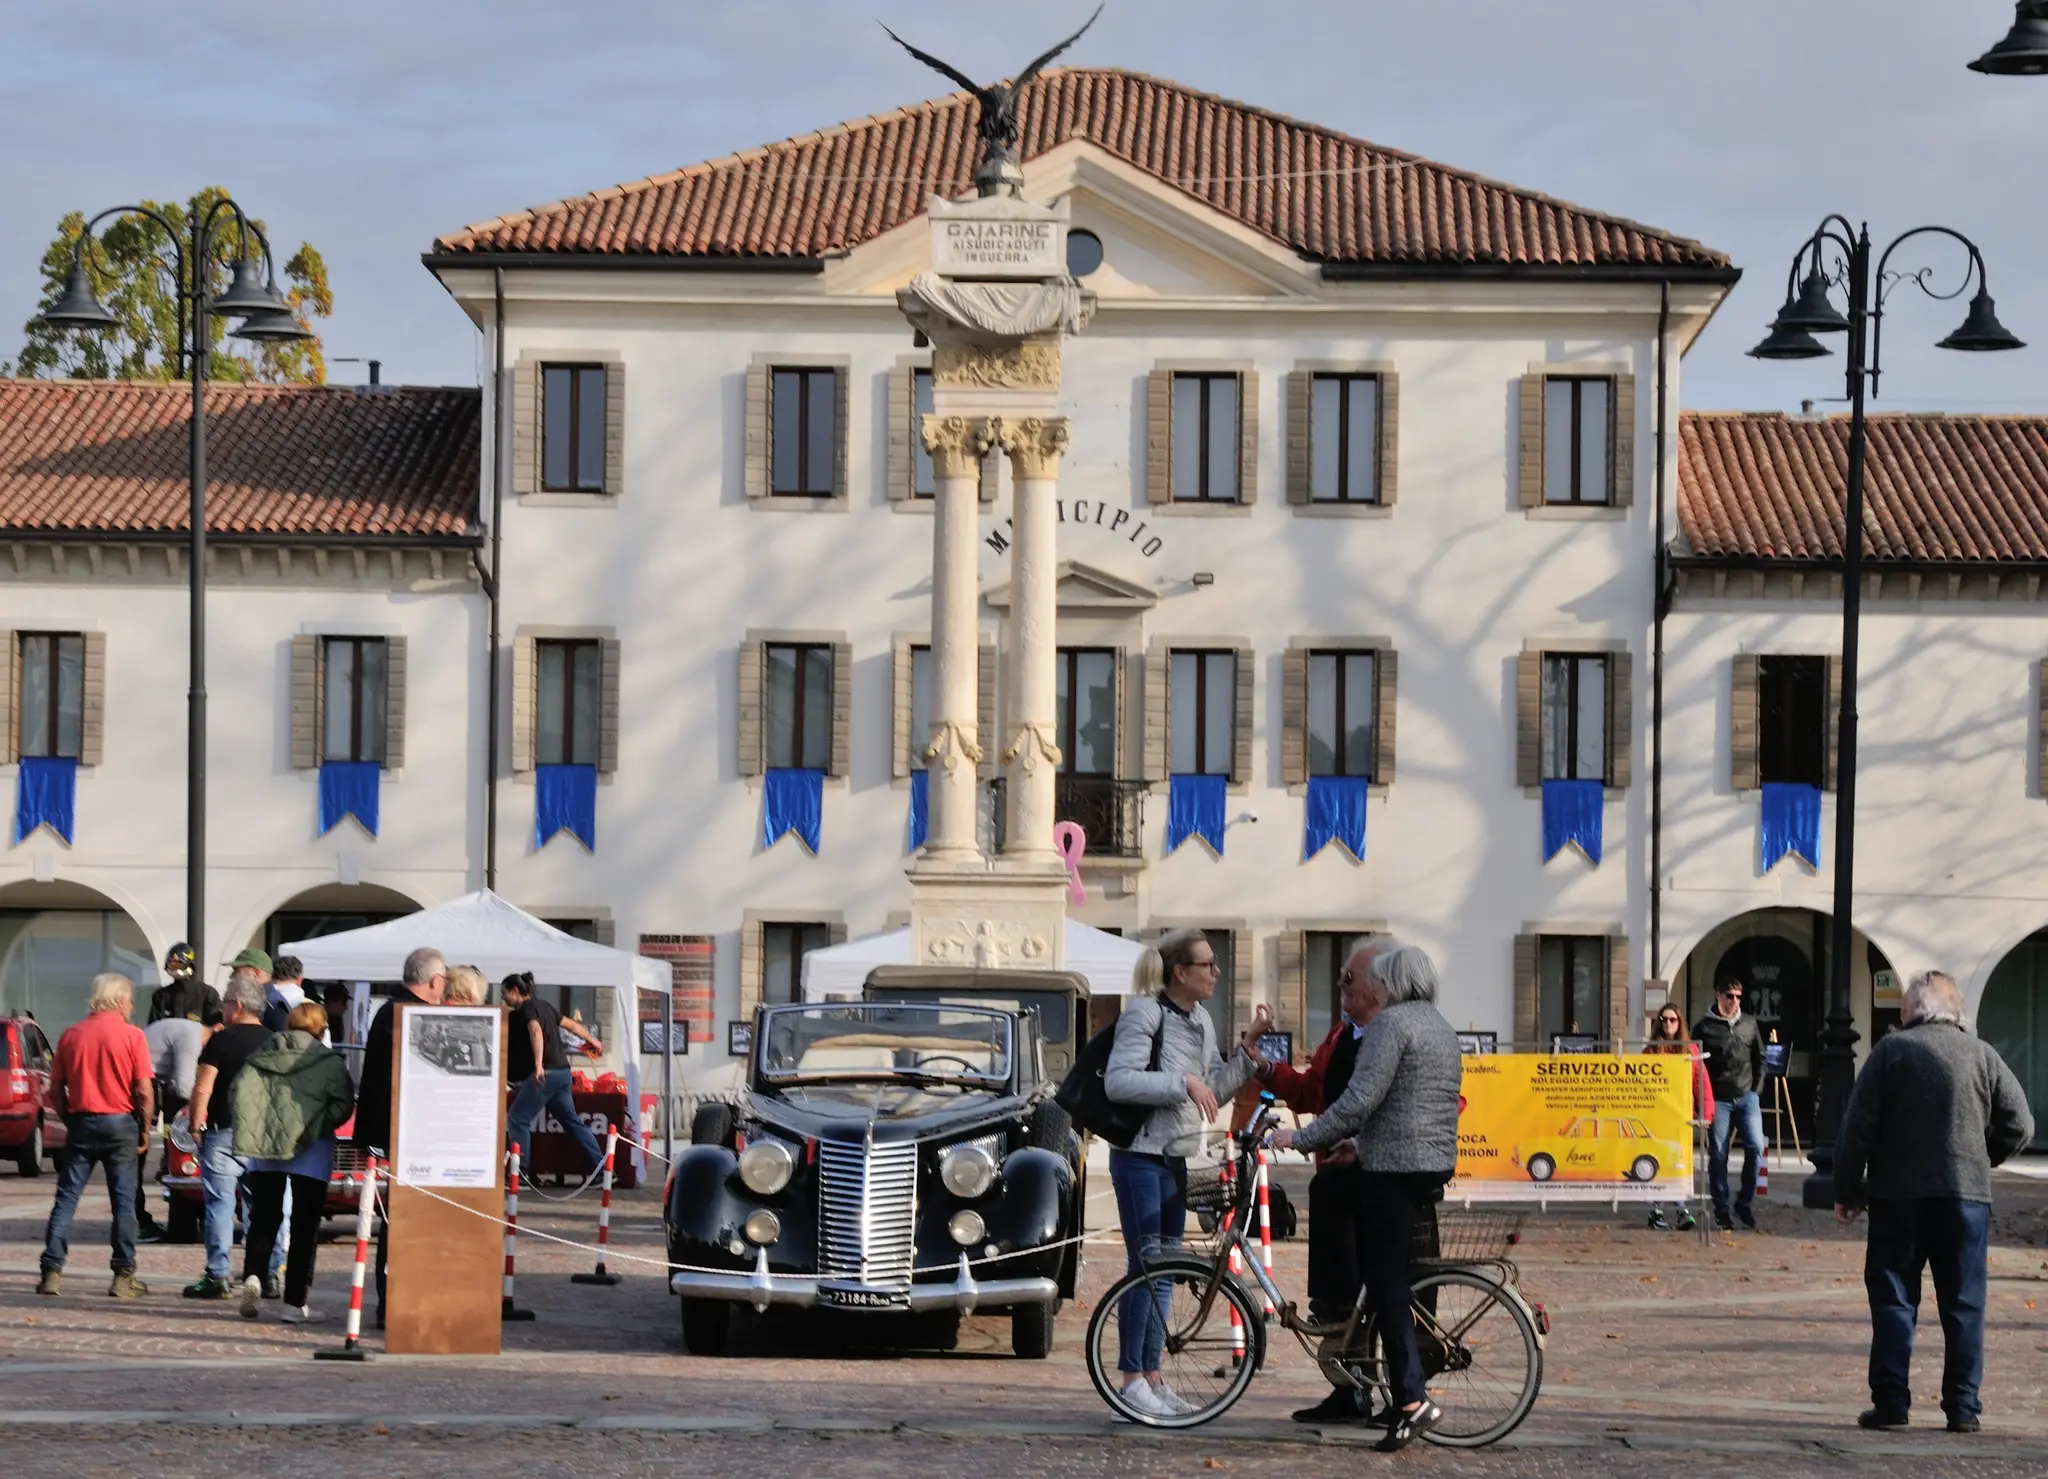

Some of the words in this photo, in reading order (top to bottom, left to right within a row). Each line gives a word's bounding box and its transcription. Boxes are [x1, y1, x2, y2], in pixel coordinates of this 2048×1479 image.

[980, 252, 1030, 263] GUERRA
[985, 499, 1162, 557] MICIPIO
[1536, 1062, 1620, 1076] SERVIZIO
[1625, 1062, 1663, 1076] NCC
[1604, 1077, 1669, 1085] CONDUCENTE
